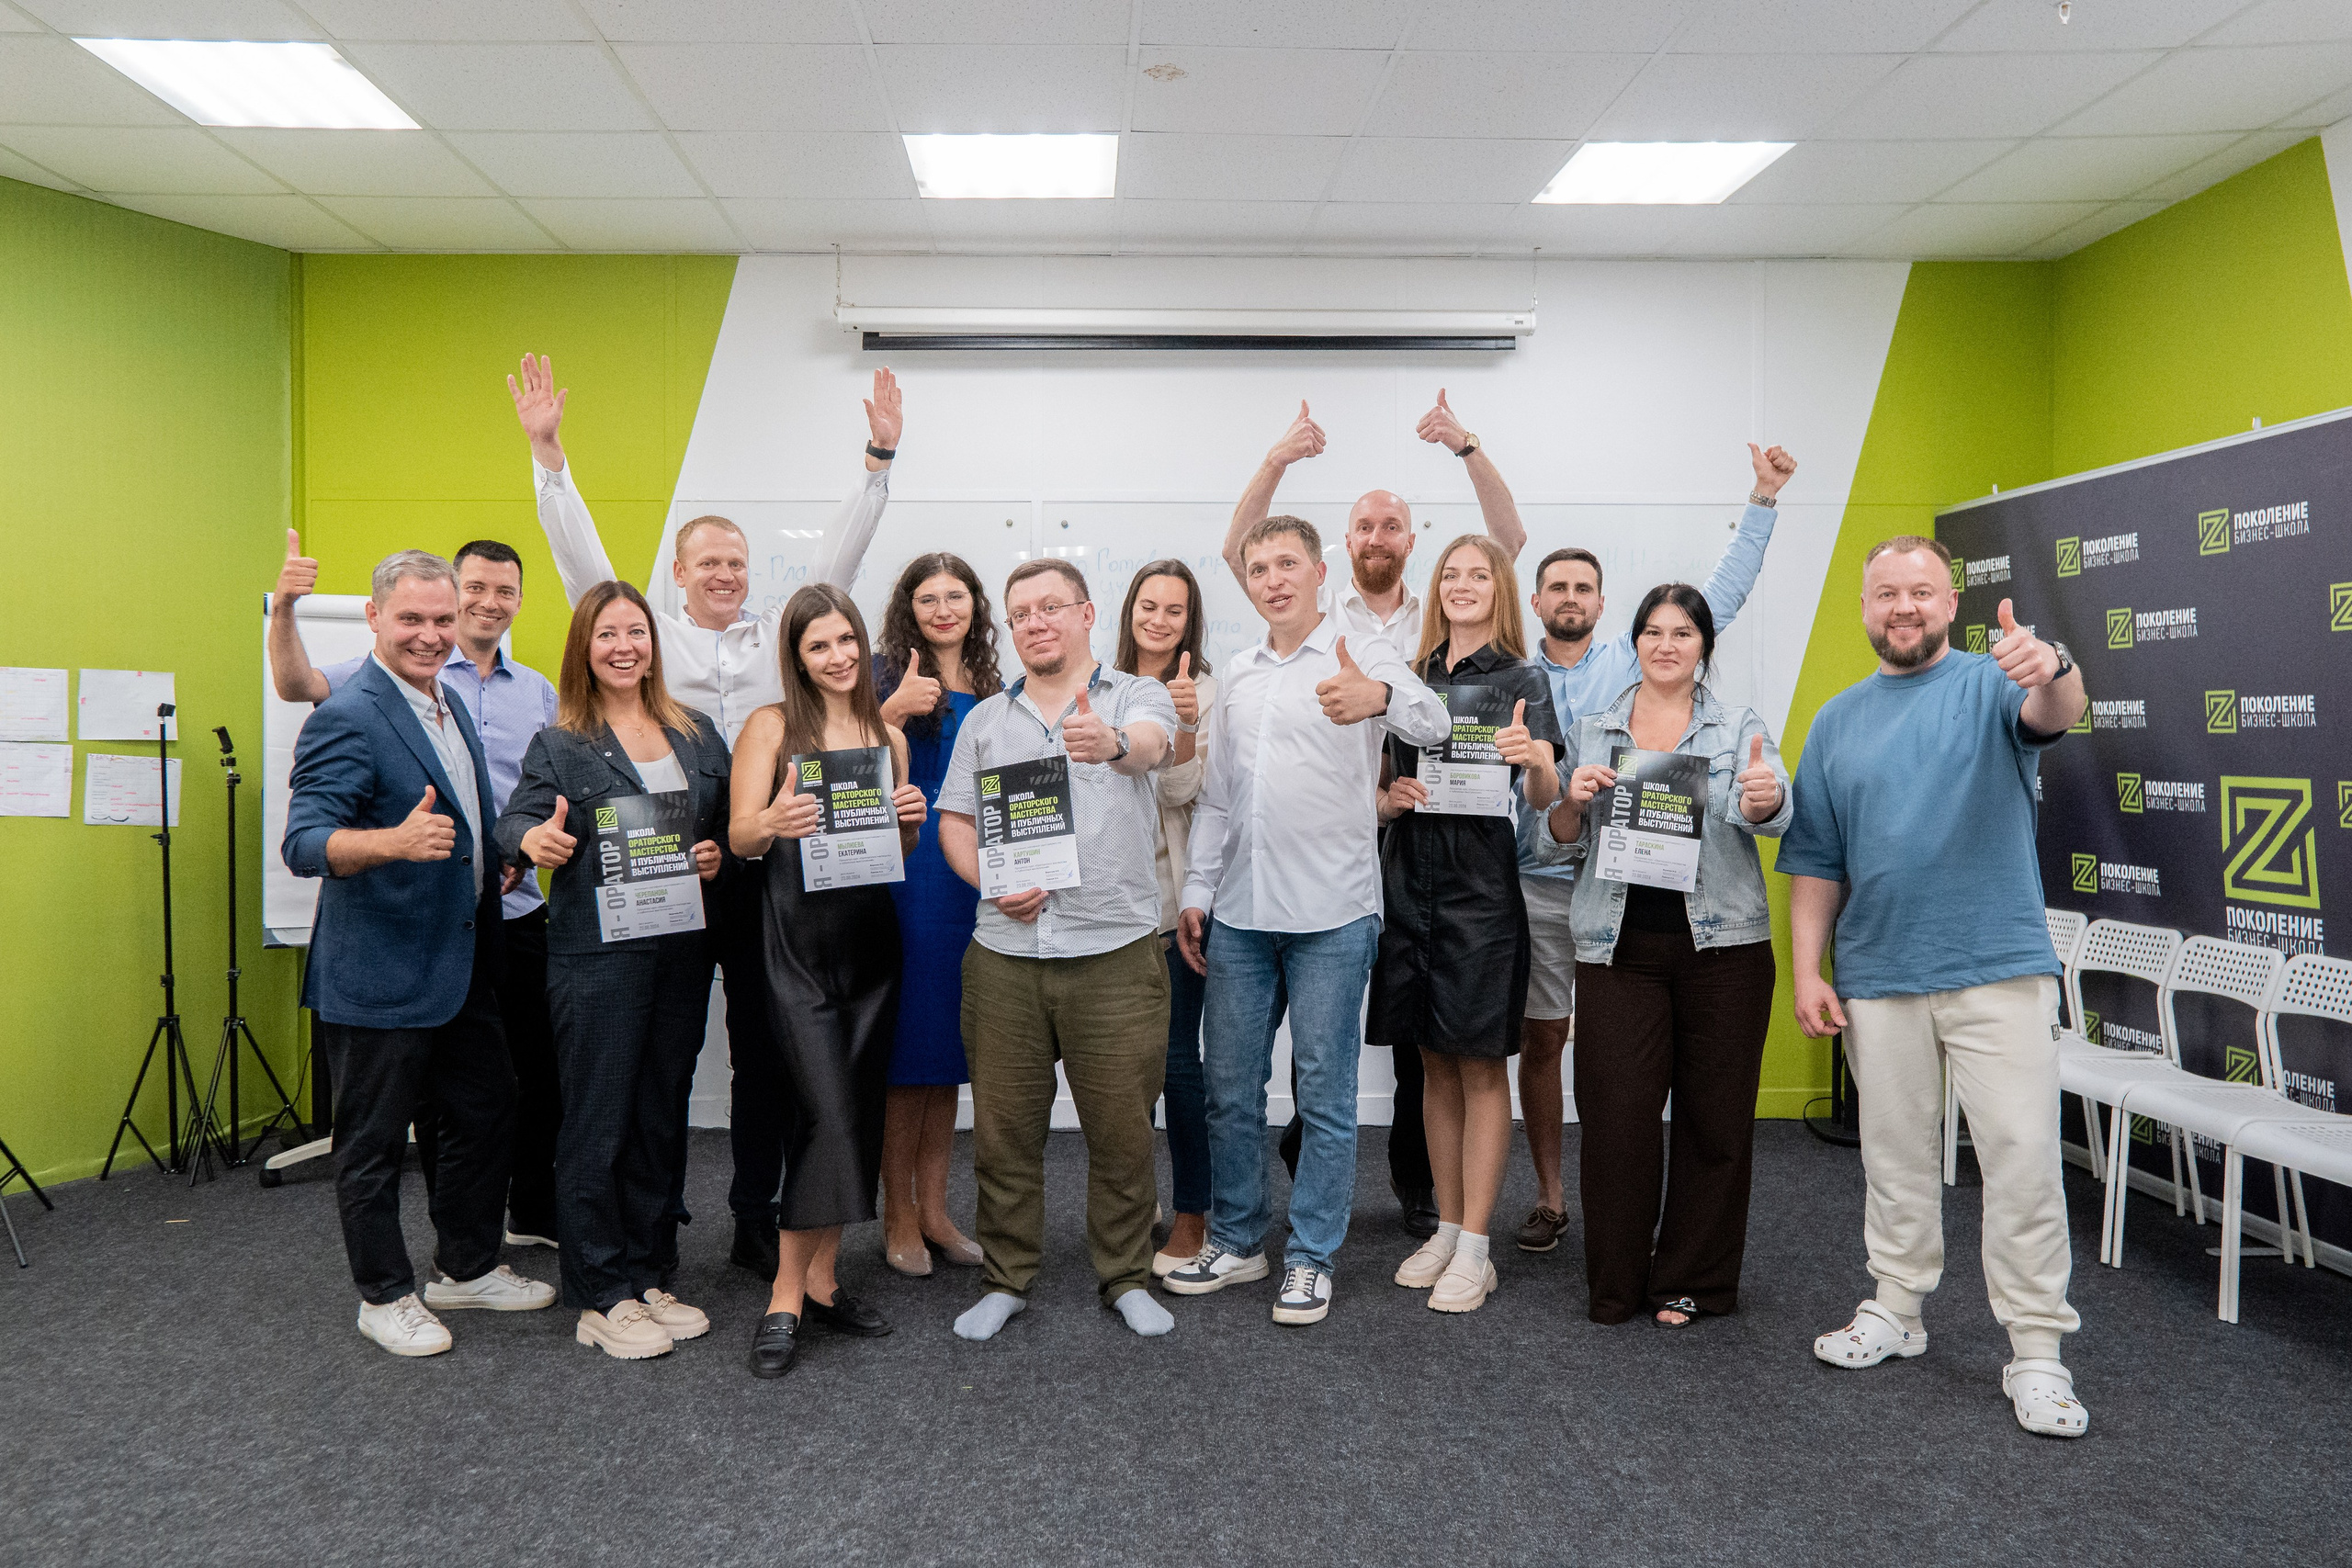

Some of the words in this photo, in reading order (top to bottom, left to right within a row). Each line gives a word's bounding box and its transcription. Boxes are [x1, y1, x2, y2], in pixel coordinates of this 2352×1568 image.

[2234, 502, 2309, 530] ПОКОЛЕНИЕ
[2234, 521, 2310, 545] БИЗНЕС-ШКОЛА
[2082, 533, 2139, 555] ПОКОЛЕНИЕ
[1966, 556, 2010, 574] ПОКОЛЕНИЕ
[2083, 549, 2140, 569] БИЗНЕС-ШКОЛА
[1966, 570, 2011, 586] БИЗНЕС-ШКОЛА
[2136, 608, 2197, 628] ПОКОЛЕНИЕ
[2136, 624, 2198, 641] БИЗНЕС-ШКОЛА
[2092, 700, 2145, 716] ПОКОЛЕНИЕ
[2241, 694, 2314, 713] ПОКОЛЕНИЕ
[2094, 715, 2146, 728] БИЗНЕС-ШКОЛА
[2241, 711, 2316, 728] БИЗНЕС-ШКОЛА
[1453, 725, 1500, 733] ОРАТОРСКОГО
[1453, 734, 1496, 742] МАСТЕРСТВА
[1458, 742, 1499, 750] ПУБЛИЧНЫ
[1425, 746, 1443, 784] ОРАТ
[831, 781, 858, 792] ШКОЛА
[1643, 782, 1669, 793] ШКОЛА
[2144, 781, 2204, 800] ПОКОЛЕНИЕ
[832, 788, 881, 801] ОРАТОРСКОГО
[1008, 792, 1035, 803] ШКОЛА
[1642, 791, 1692, 805] ОРАТОРСКОГО
[832, 799, 879, 810] МАСТЕРСТВА
[1009, 796, 1058, 811] ОРАТОРСКОГО
[1423, 802, 1440, 811] Я
[1640, 801, 1688, 814] МАСТЕРСТВА
[2146, 796, 2206, 812] БИЗНЕС-ШКОЛА
[834, 811, 840, 819] И
[841, 806, 887, 818] ПУБЛИЧНЫХ
[1011, 807, 1056, 819] МАСТЕРСТВА
[1608, 785, 1633, 852] ОРАТОР
[1646, 810, 1693, 823] ПУБЛИЧНЫХ
[835, 814, 889, 829] ВЫСТУПЛЕНИЙ
[1011, 820, 1017, 829] И
[1018, 813, 1063, 827] ПУБЛИЧНЫХ
[1638, 818, 1694, 833] ВЫСТУПЛЕНИЙ
[627, 827, 656, 839] ШКОЛА
[1012, 821, 1066, 837] ВЫСТУПЛЕНИЙ
[628, 834, 680, 848] ОРАТОРСКОГО
[983, 806, 1005, 869] ОРАТОР
[629, 844, 678, 857] МАСТЕРСТВА
[838, 848, 866, 857] ЕКАТЕРИНА
[1634, 848, 1651, 856] ЕЛЕНА
[630, 858, 637, 866] И
[638, 852, 686, 865] ПУБЛИЧНЫХ
[1014, 857, 1031, 865] АНТОН
[600, 840, 627, 909] ОРАТОР
[632, 861, 689, 876] ВЫСТУПЛЕНИЙ
[1604, 867, 1623, 880] Я
[2100, 862, 2159, 884] ПОКОЛЕНИЕ
[814, 877, 832, 888] Я
[2101, 877, 2161, 897] БИЗНЕС-ШКОЛА
[989, 885, 1008, 896] Я
[636, 897, 666, 907] АНАСТАСИЯ
[2226, 906, 2324, 942] ПОКОЛЕНИЕ
[611, 927, 630, 939] Я
[2104, 1021, 2162, 1050] ПОКОЛЕНИЕ
